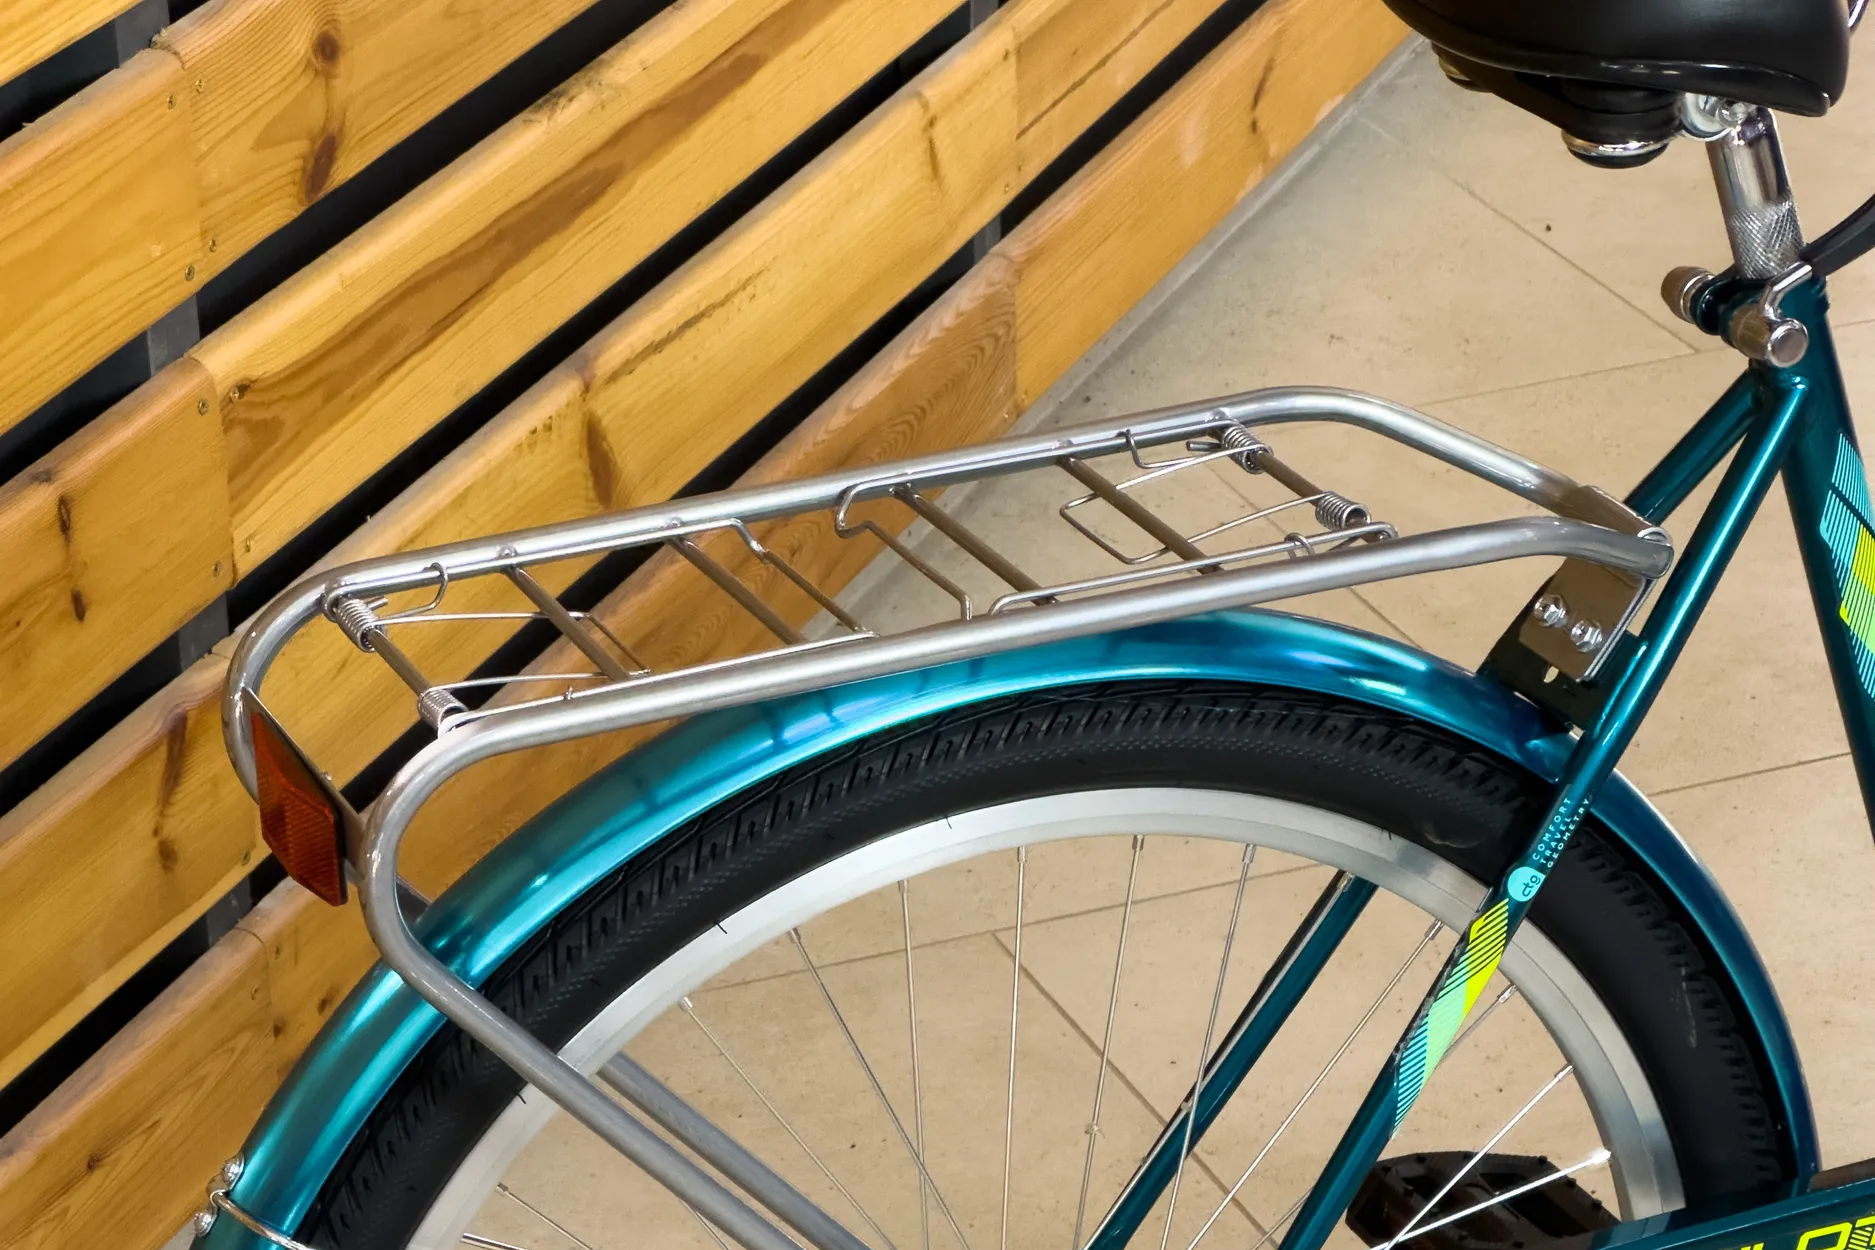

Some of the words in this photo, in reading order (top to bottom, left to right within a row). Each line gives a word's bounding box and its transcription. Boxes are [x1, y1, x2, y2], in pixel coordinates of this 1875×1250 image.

[1532, 797, 1571, 860] COMFORT
[1540, 816, 1572, 864] TRAVEL
[1547, 798, 1590, 868] GEOMETRY
[1521, 874, 1541, 898] ctg
